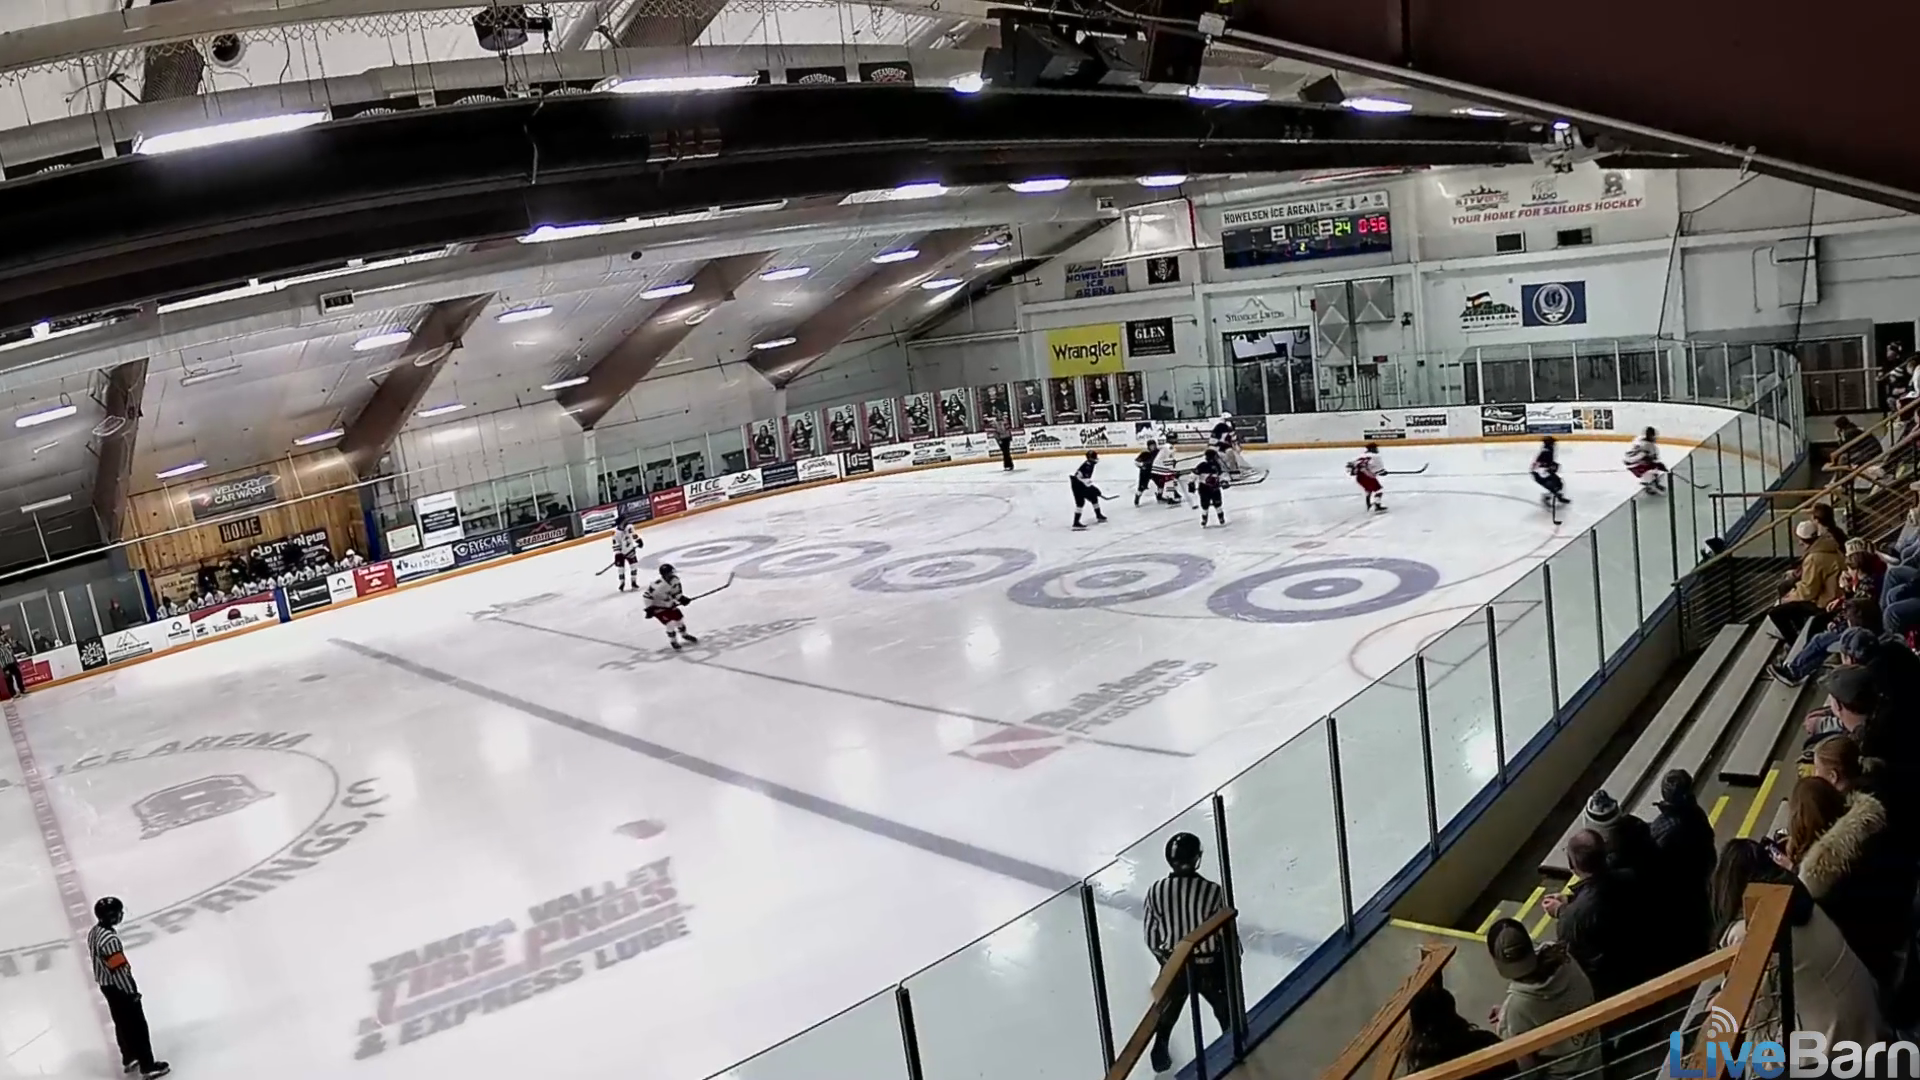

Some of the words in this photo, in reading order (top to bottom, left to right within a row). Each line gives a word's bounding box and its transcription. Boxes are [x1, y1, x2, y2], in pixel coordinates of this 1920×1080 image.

[1224, 207, 1269, 224] HOWELSEN
[1271, 207, 1285, 218] ICE
[1287, 203, 1316, 216] ARENA
[1452, 213, 1481, 225] YOUR
[1483, 211, 1515, 222] HOME
[1518, 207, 1540, 218] FOR
[1542, 203, 1592, 215] SAILORS
[1594, 198, 1643, 210] HOCKEY
[1334, 221, 1352, 236] 24
[1357, 216, 1388, 233] 0:56
[1066, 268, 1125, 283] HOWELSEN
[1086, 280, 1104, 288] ICE
[1075, 286, 1115, 298] ARENA
[1134, 326, 1166, 339] GLEN
[1052, 341, 1118, 364] Wrangler
[1483, 422, 1526, 433] STORAGE
[214, 493, 236, 504] CAR
[236, 486, 266, 499] WASH
[221, 518, 260, 542] HOME
[305, 531, 327, 546] PUB
[147, 732, 313, 756] ARENA
[354, 1032, 387, 1061] &
[399, 959, 584, 1046] EXPRESS
[595, 916, 692, 971] LUBE
